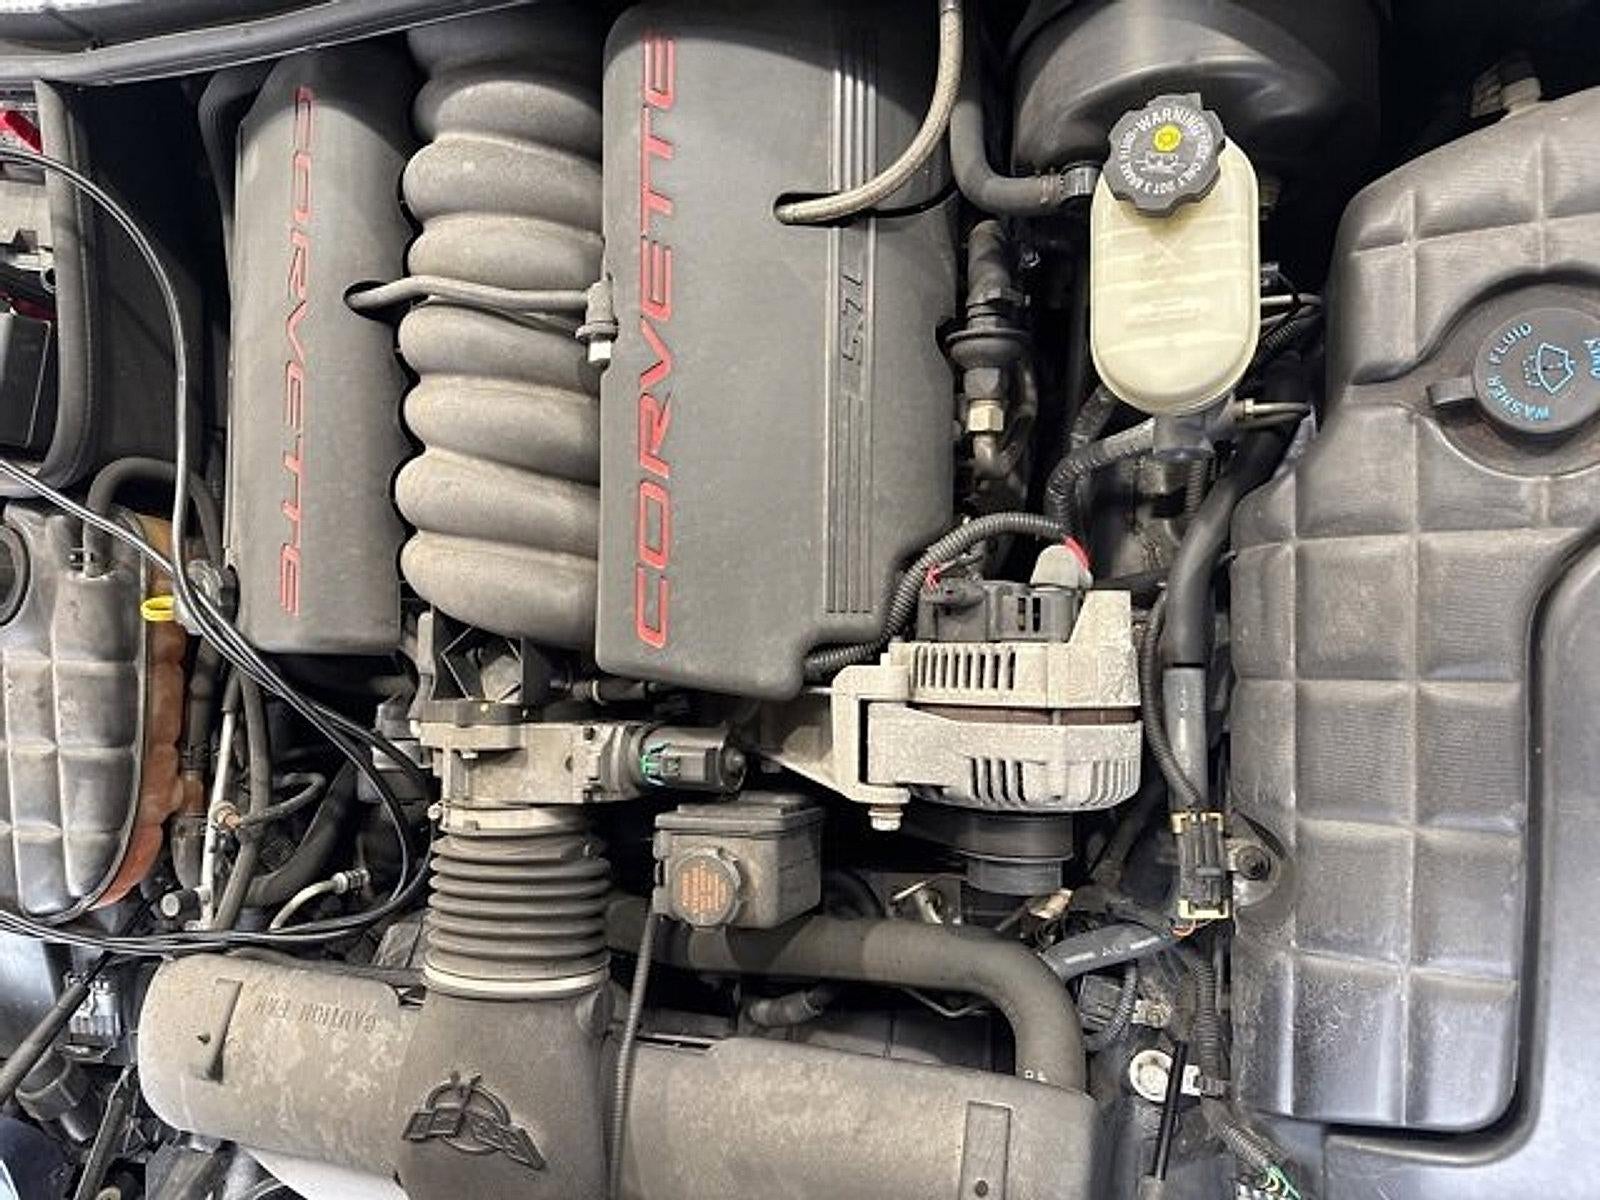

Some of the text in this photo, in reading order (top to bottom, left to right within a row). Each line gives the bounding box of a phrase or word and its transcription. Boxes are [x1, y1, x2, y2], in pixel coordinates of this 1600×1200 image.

[1136, 107, 1202, 136] WARNING
[280, 85, 314, 617] CORVETTE
[635, 27, 676, 649] CORVETTE
[1489, 322, 1532, 365] FLUID
[1486, 375, 1549, 421] WASHER
